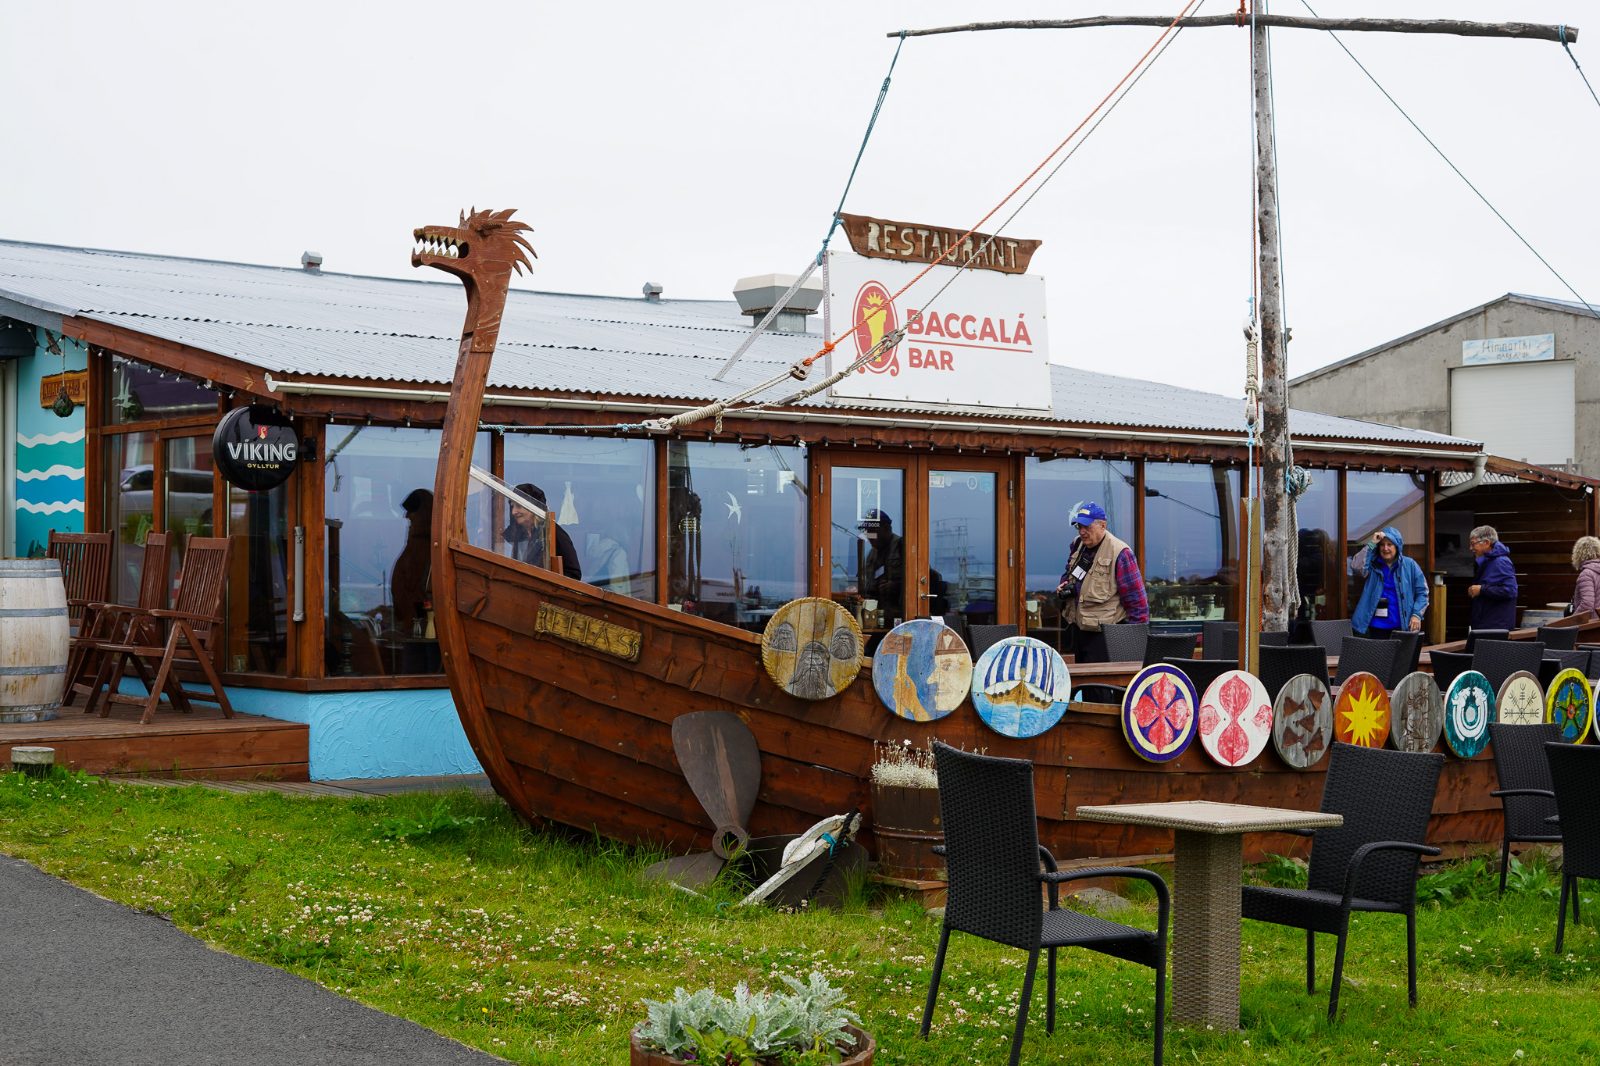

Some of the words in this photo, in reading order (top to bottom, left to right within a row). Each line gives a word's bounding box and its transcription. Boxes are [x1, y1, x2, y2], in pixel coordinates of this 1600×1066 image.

[867, 222, 1020, 269] RESTAURANT
[906, 309, 1032, 345] BACCALÁ
[908, 347, 955, 371] BAR
[227, 438, 296, 461] VÍKING
